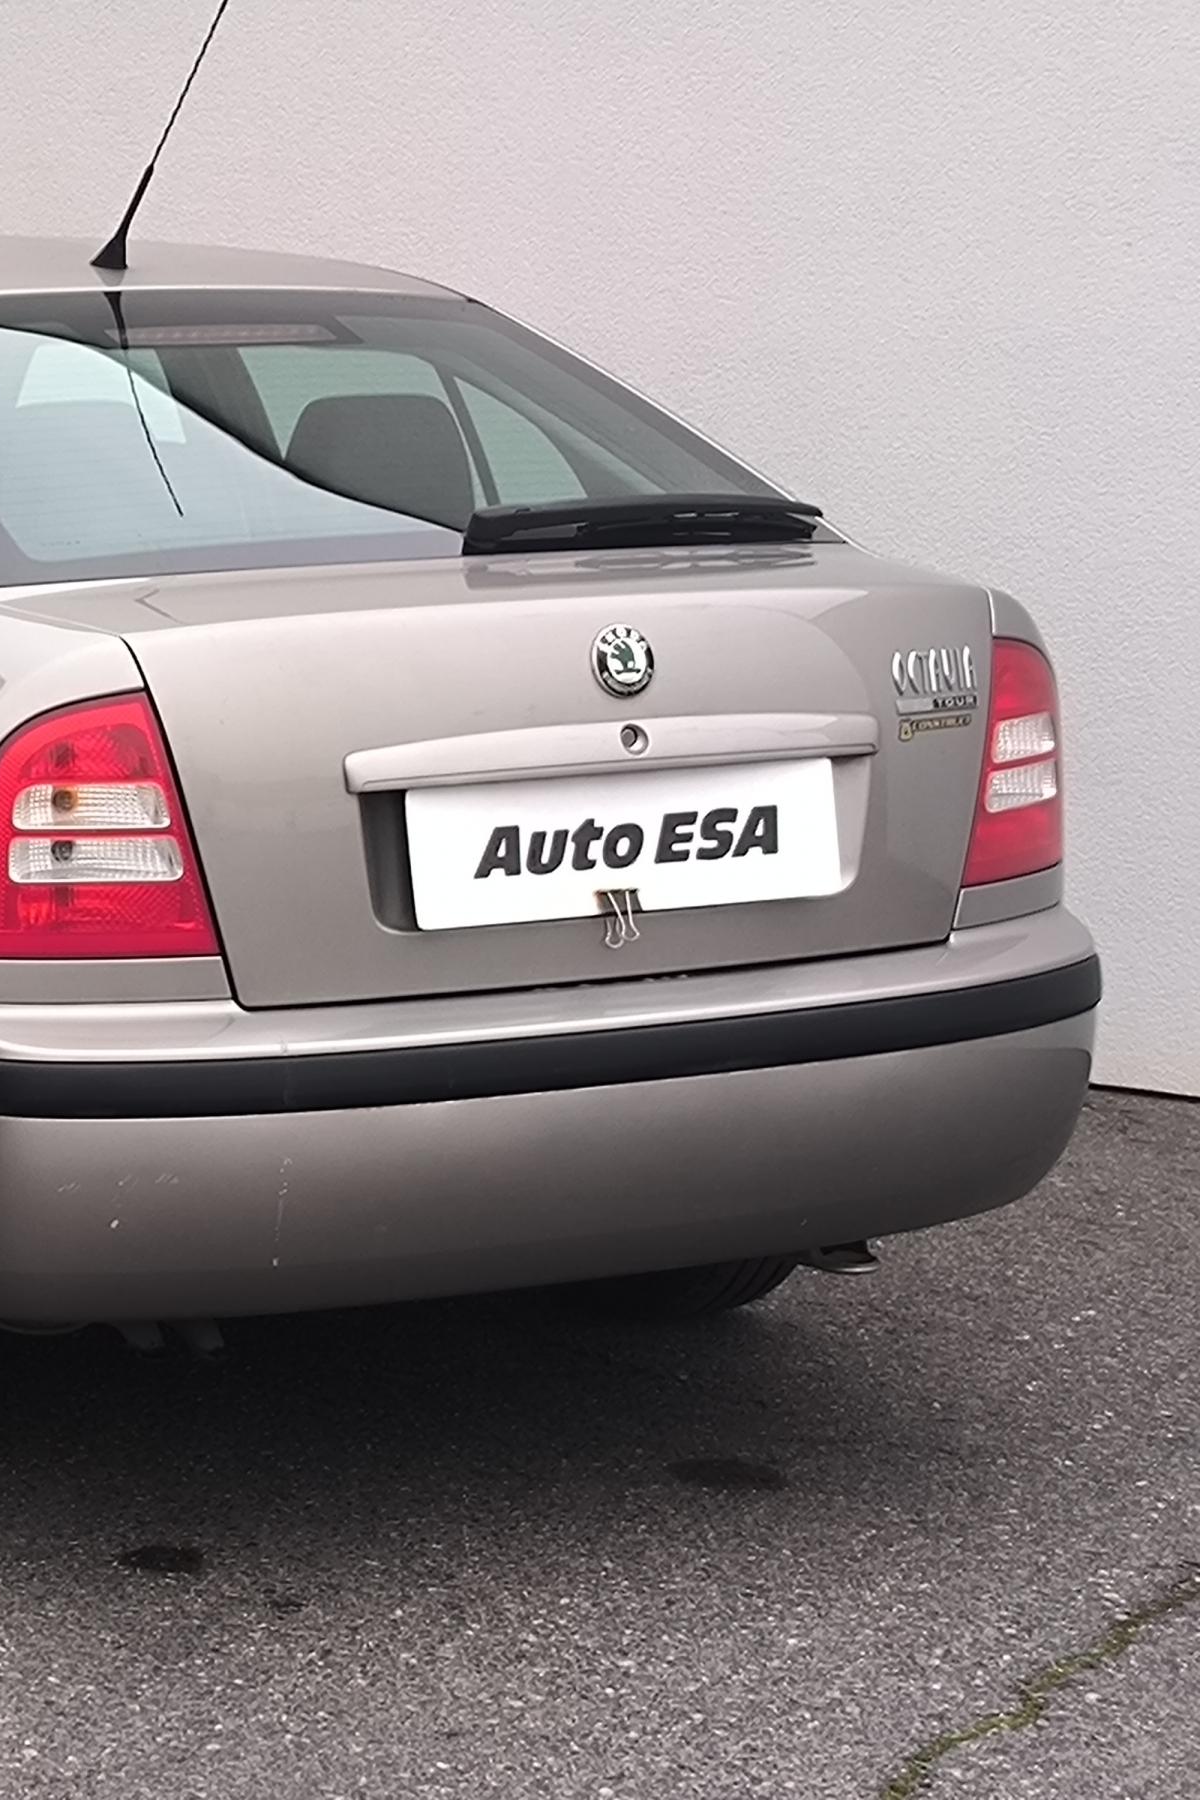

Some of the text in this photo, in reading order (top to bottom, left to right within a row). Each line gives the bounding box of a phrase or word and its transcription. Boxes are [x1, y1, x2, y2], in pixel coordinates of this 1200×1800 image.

[891, 644, 978, 696] OCTAVIA
[937, 695, 976, 708] TOUR
[474, 804, 779, 879] Auto ESA
